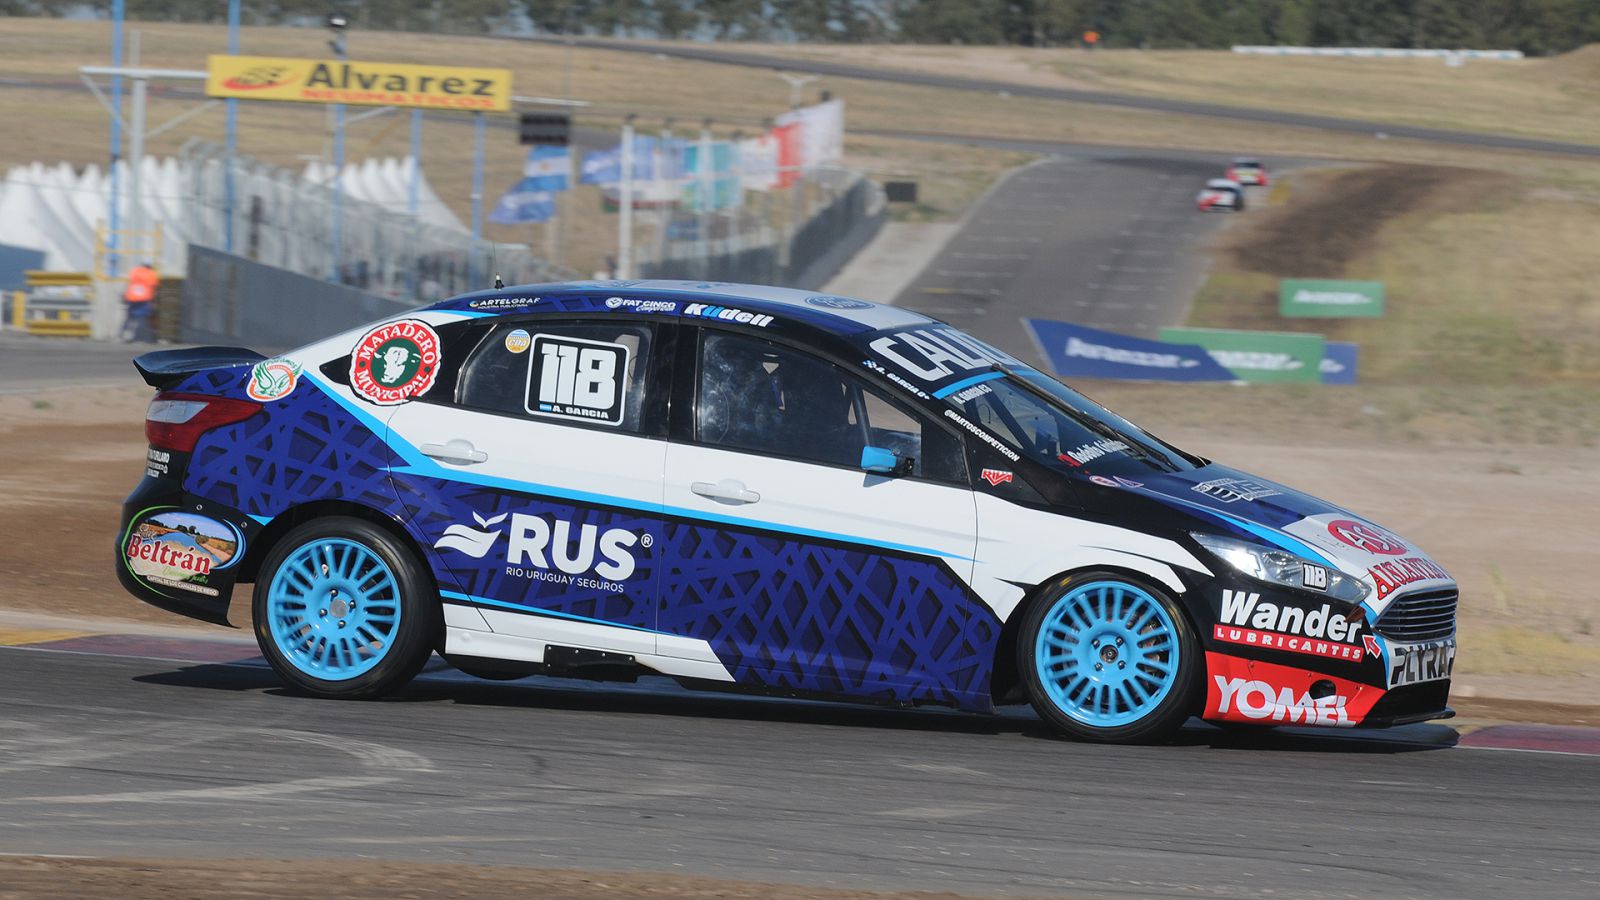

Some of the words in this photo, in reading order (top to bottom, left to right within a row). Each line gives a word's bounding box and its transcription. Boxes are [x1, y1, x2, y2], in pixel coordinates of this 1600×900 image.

[305, 63, 495, 97] Alvarez
[623, 299, 642, 307] FAT
[643, 301, 677, 309] CINCO
[359, 324, 436, 364] MATADERO
[356, 369, 430, 400] MUNICIPAL
[539, 342, 617, 410] 118
[552, 404, 564, 413] A.
[565, 406, 609, 419] GARCIA
[944, 409, 1021, 462] @MARTOSCOMPETICION
[127, 534, 211, 574] Beltrán
[506, 566, 523, 577] RIO
[526, 570, 575, 585] URUGUAY
[577, 578, 624, 593] SEGUROS
[1304, 565, 1326, 588] 118
[1220, 589, 1362, 643] Wander
[1217, 627, 1361, 660] LUBRICANTES
[1214, 675, 1356, 727] YOMEL
